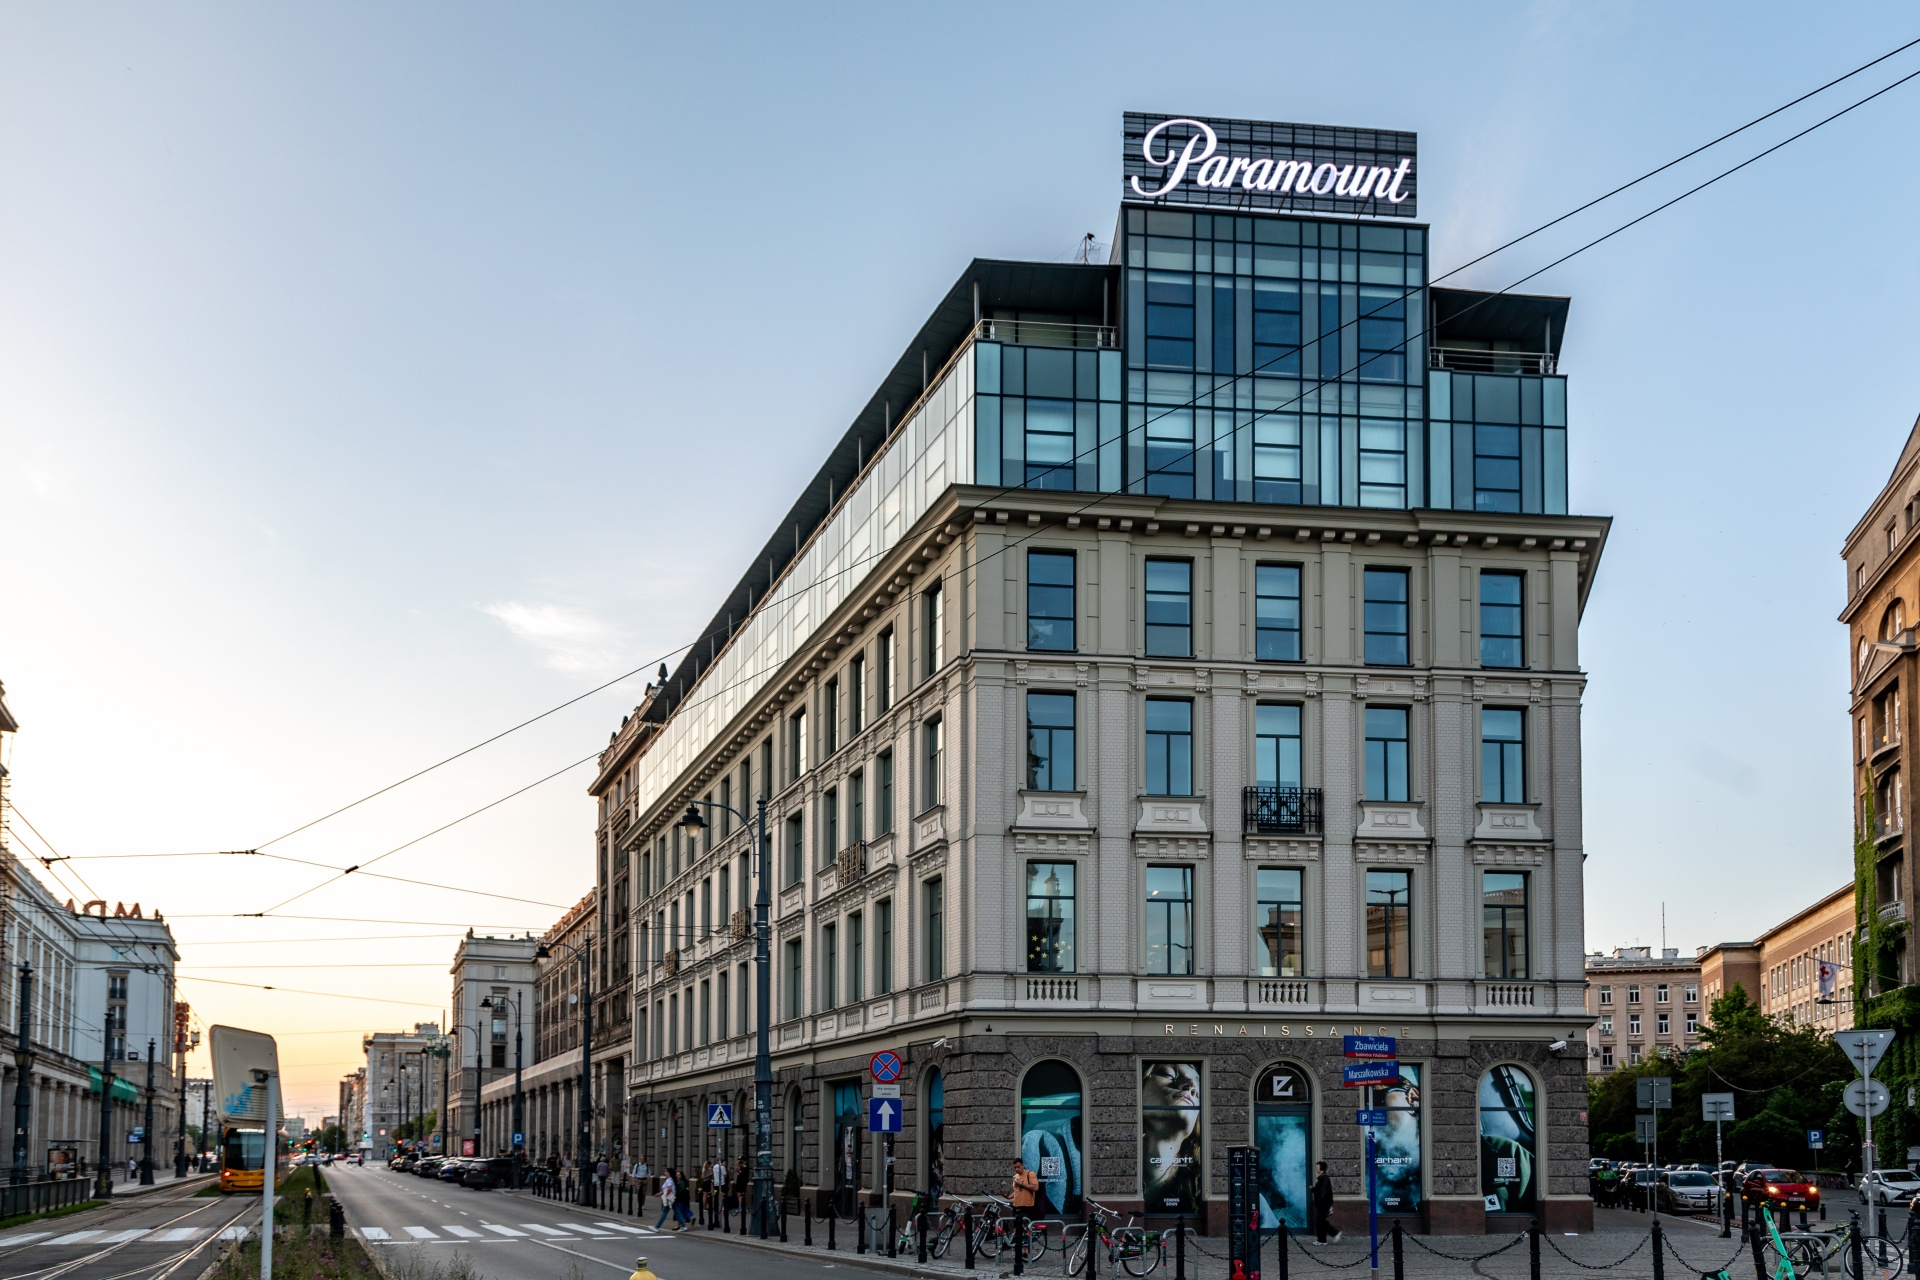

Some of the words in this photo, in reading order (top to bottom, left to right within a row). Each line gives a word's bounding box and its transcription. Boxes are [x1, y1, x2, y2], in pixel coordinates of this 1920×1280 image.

[1131, 118, 1411, 203] Paramount
[175, 1002, 189, 1052] HOTEL
[1165, 1024, 1409, 1037] RENAISSANCE
[1354, 1040, 1388, 1051] Zbawiciela
[1348, 1067, 1389, 1079] Marszałkowska
[514, 1133, 522, 1143] P
[1811, 1131, 1820, 1141] P
